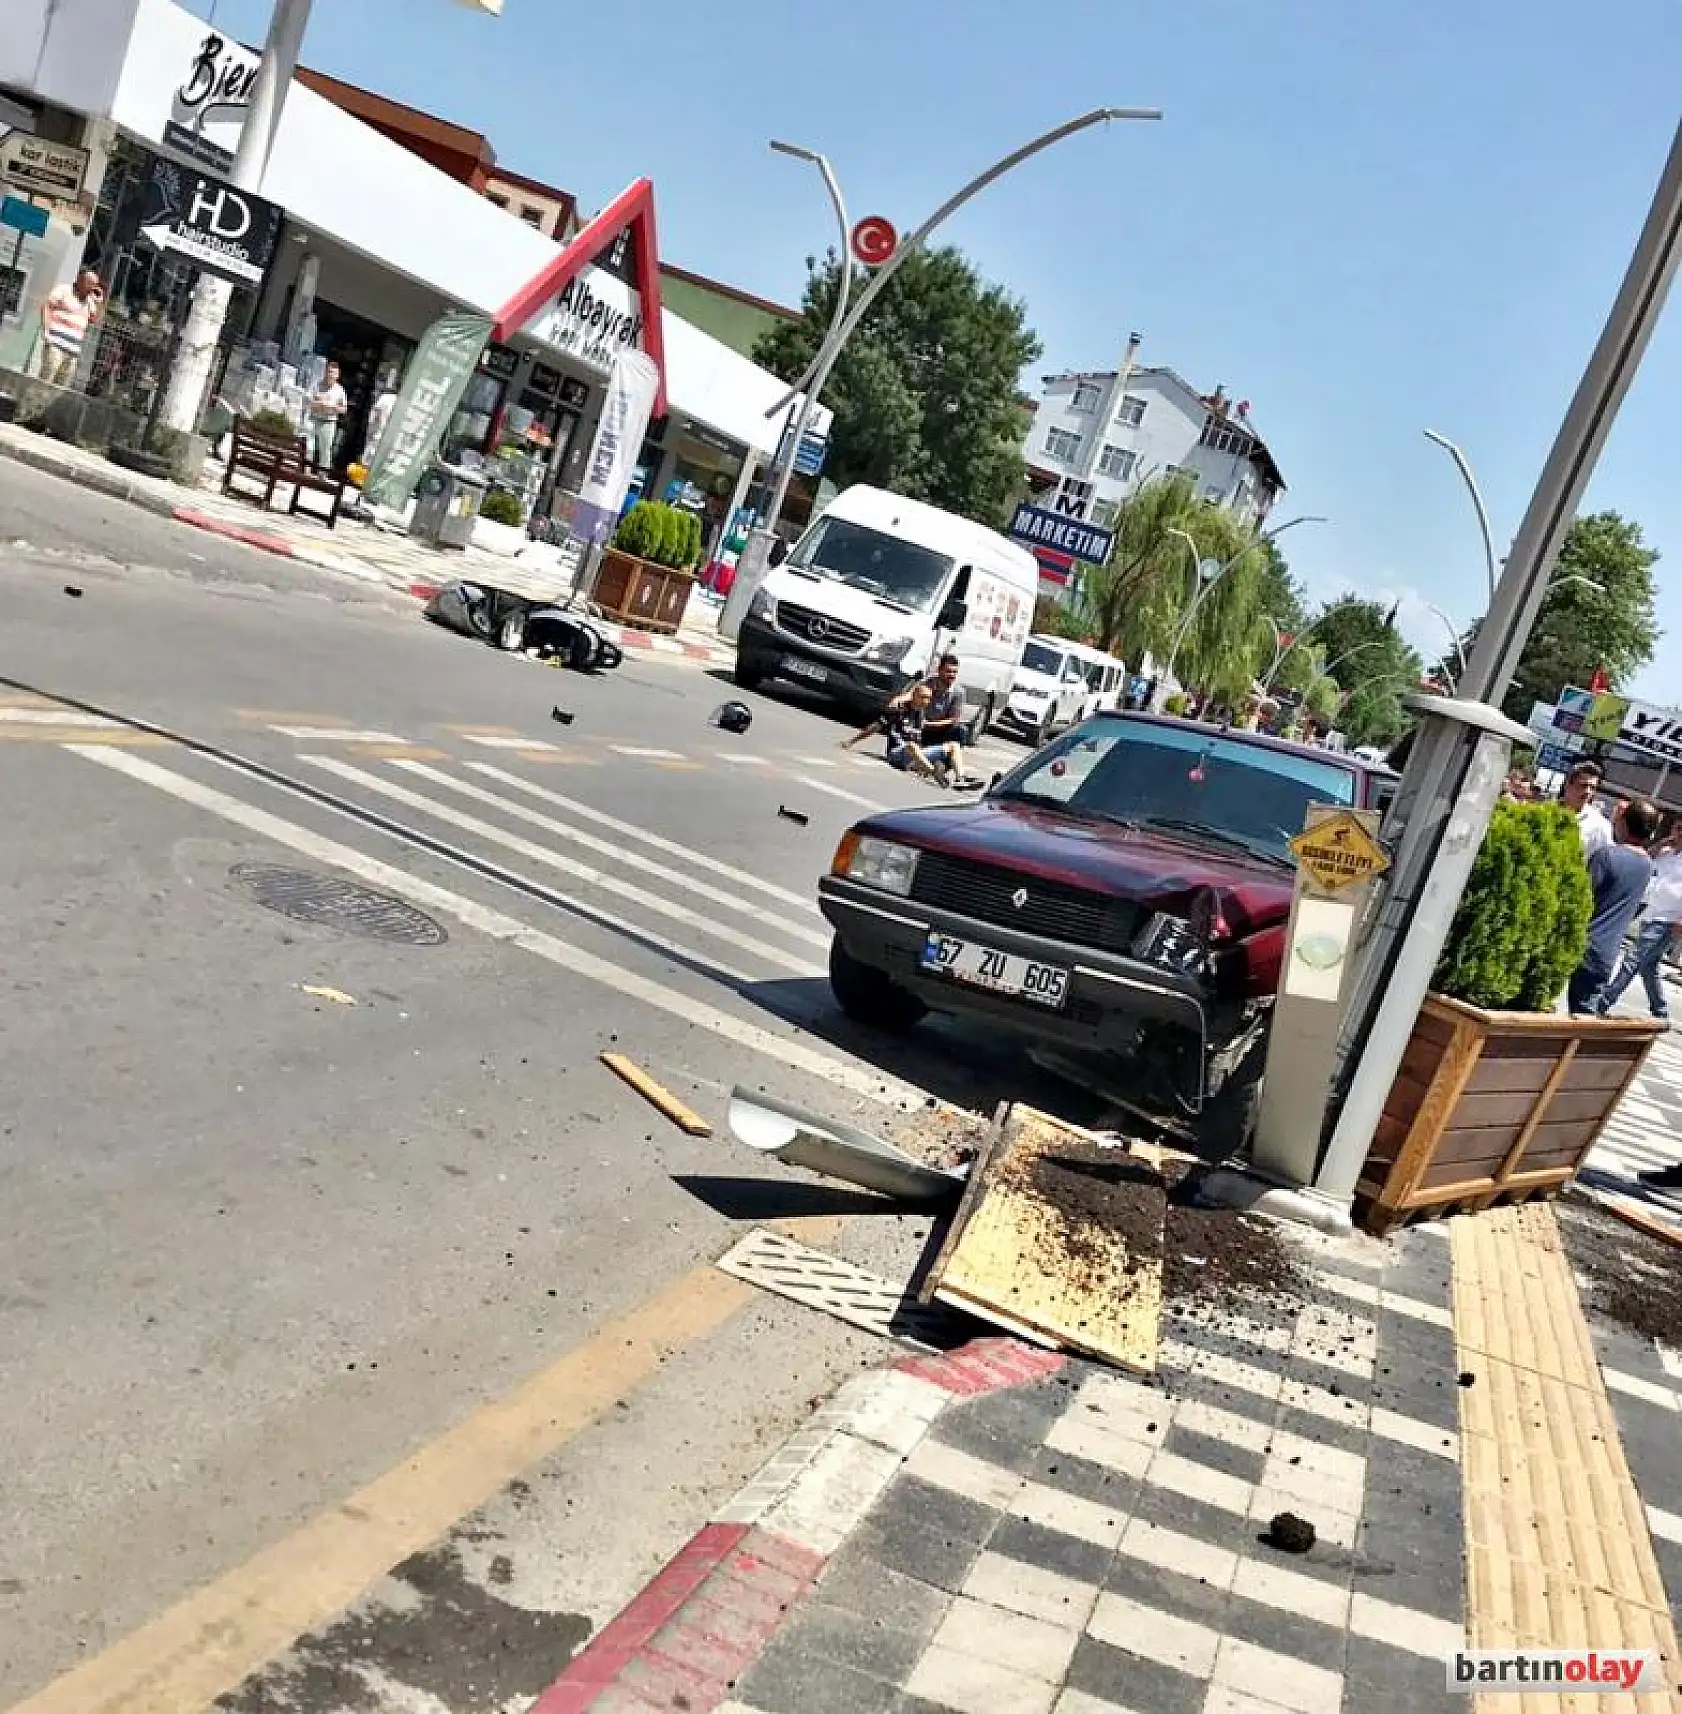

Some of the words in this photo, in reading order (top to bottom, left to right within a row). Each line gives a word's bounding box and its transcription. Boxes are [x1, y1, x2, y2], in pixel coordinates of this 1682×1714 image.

[556, 275, 643, 349] Albayrak
[939, 938, 964, 963] 67
[977, 950, 1007, 978] ZU
[1024, 963, 1066, 996] 605
